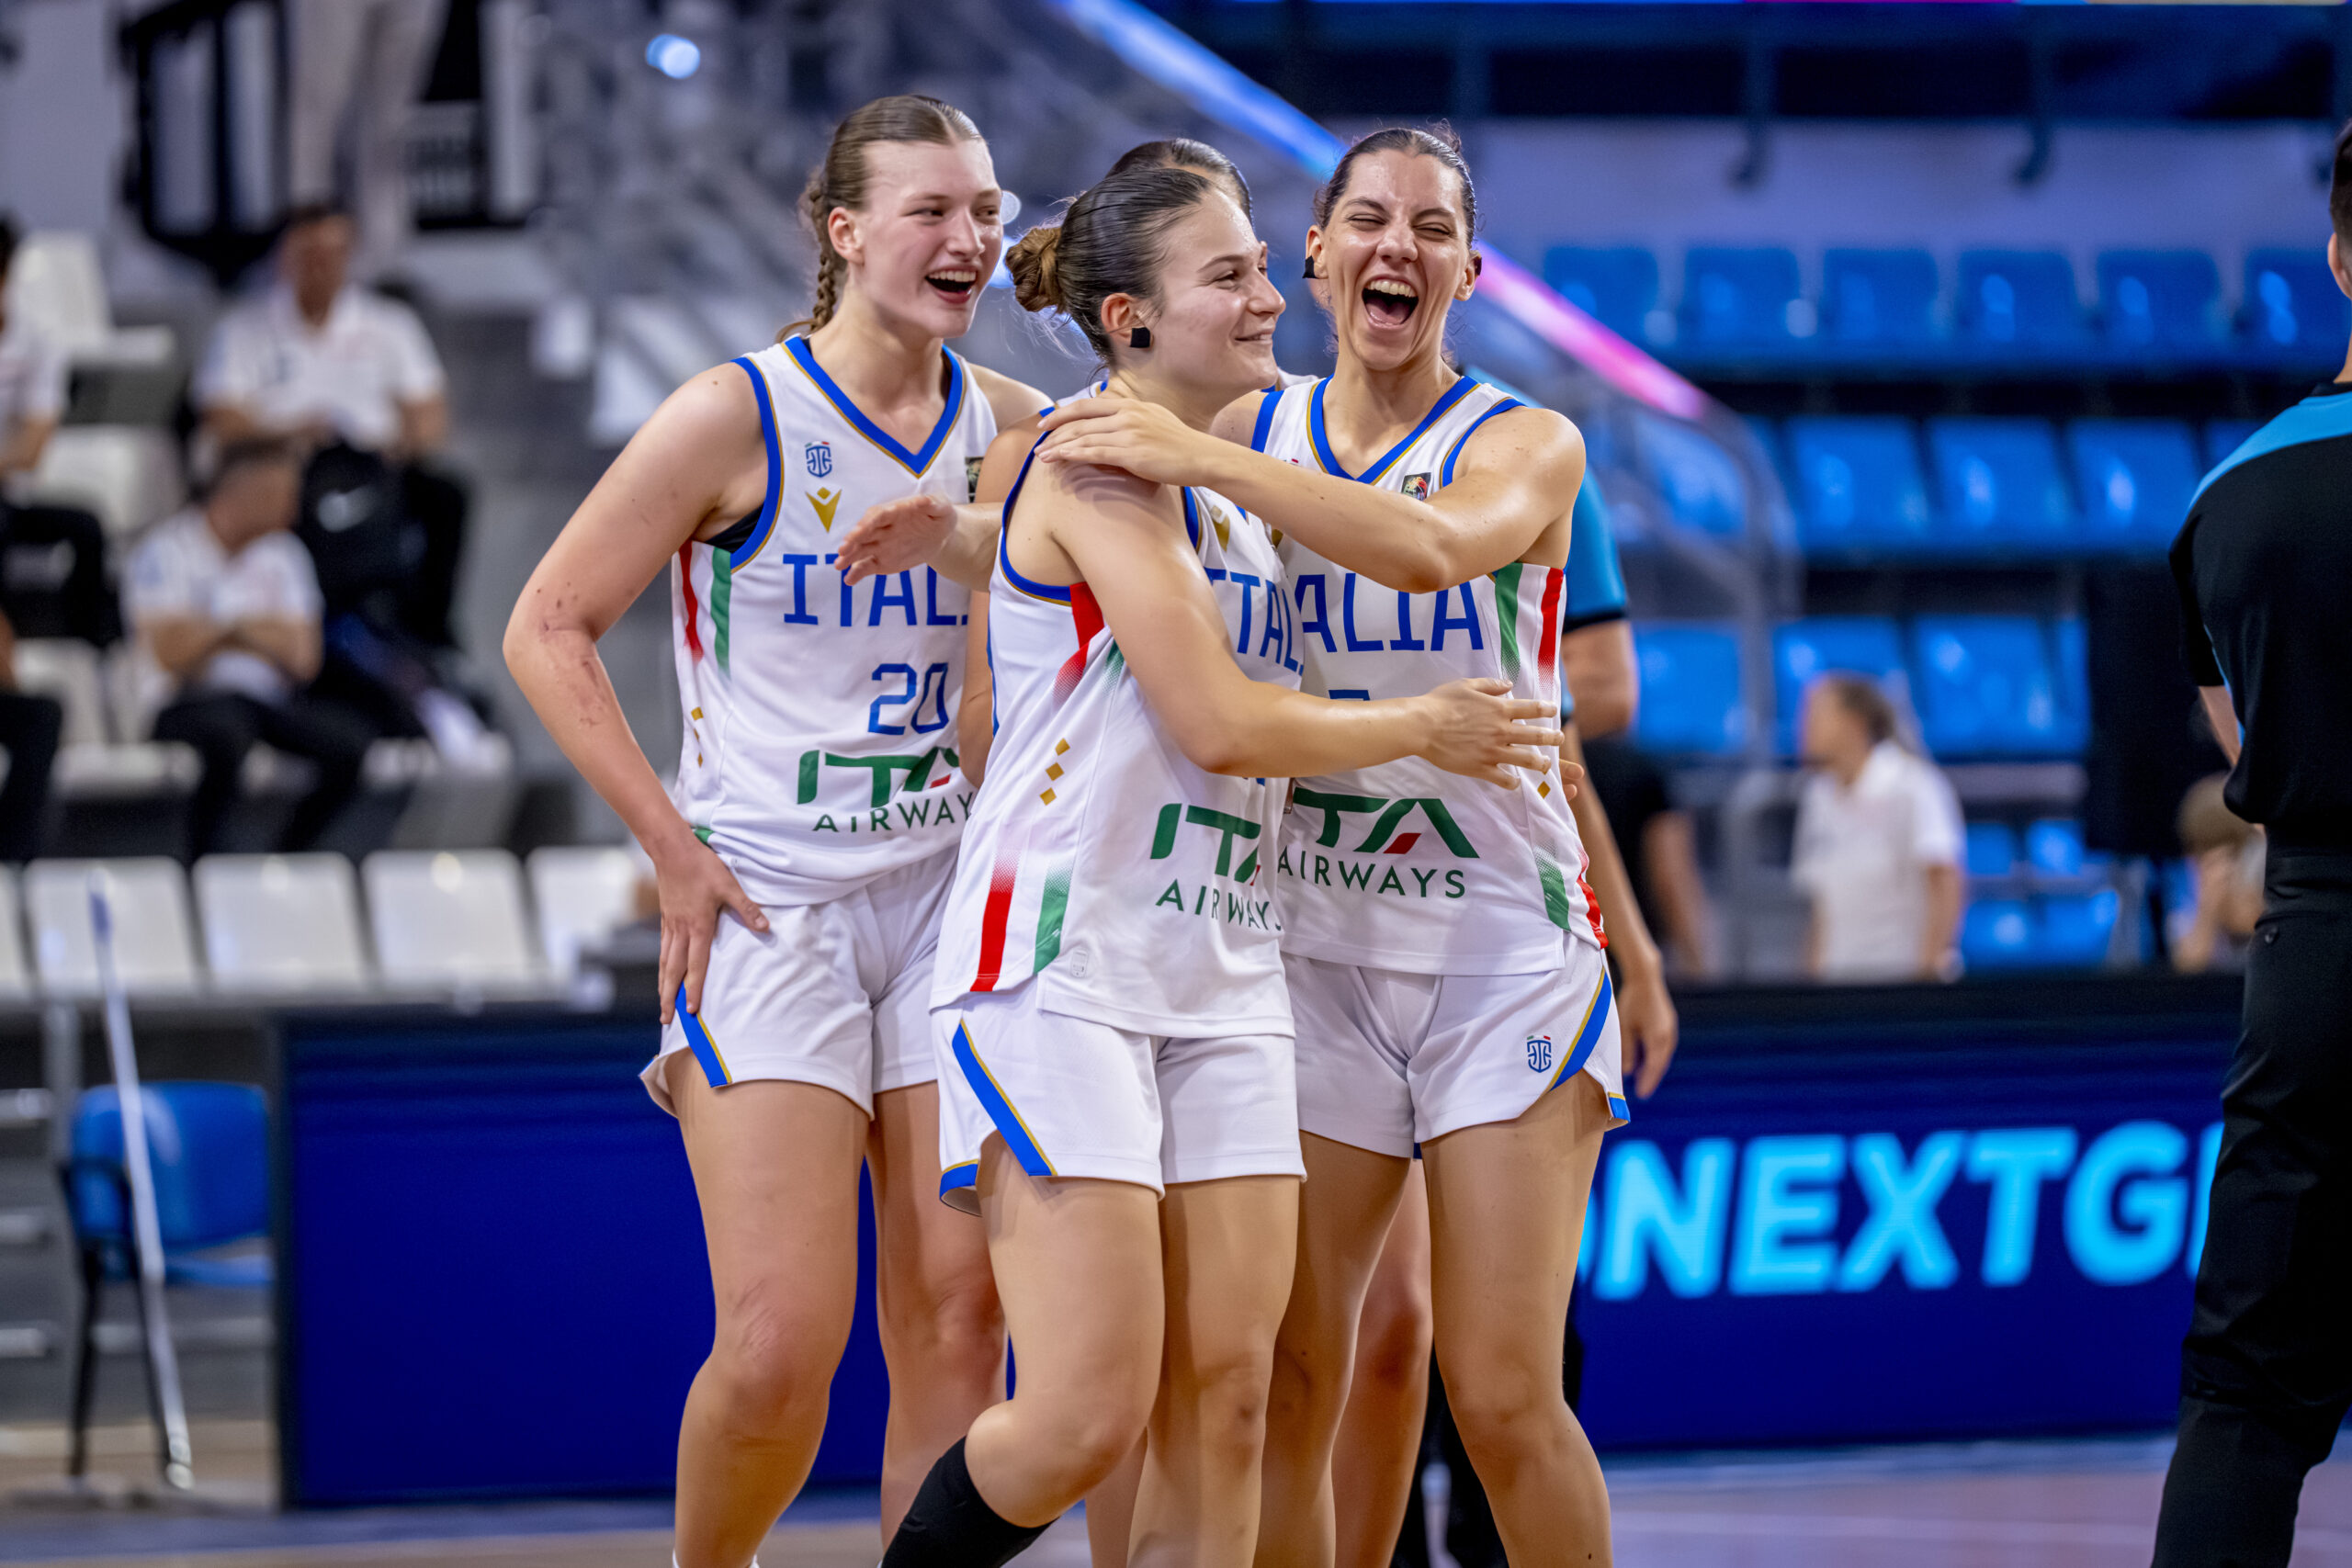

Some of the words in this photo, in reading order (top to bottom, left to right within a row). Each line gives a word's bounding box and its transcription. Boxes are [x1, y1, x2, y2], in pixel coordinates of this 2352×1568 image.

[782, 553, 968, 626] ITAL
[1204, 566, 1304, 676] TAL
[867, 661, 949, 735] 20
[1155, 878, 1282, 931] AIRWAY
[1277, 845, 1465, 898] AIRWAYS
[1577, 1120, 2224, 1302] NEXTG
